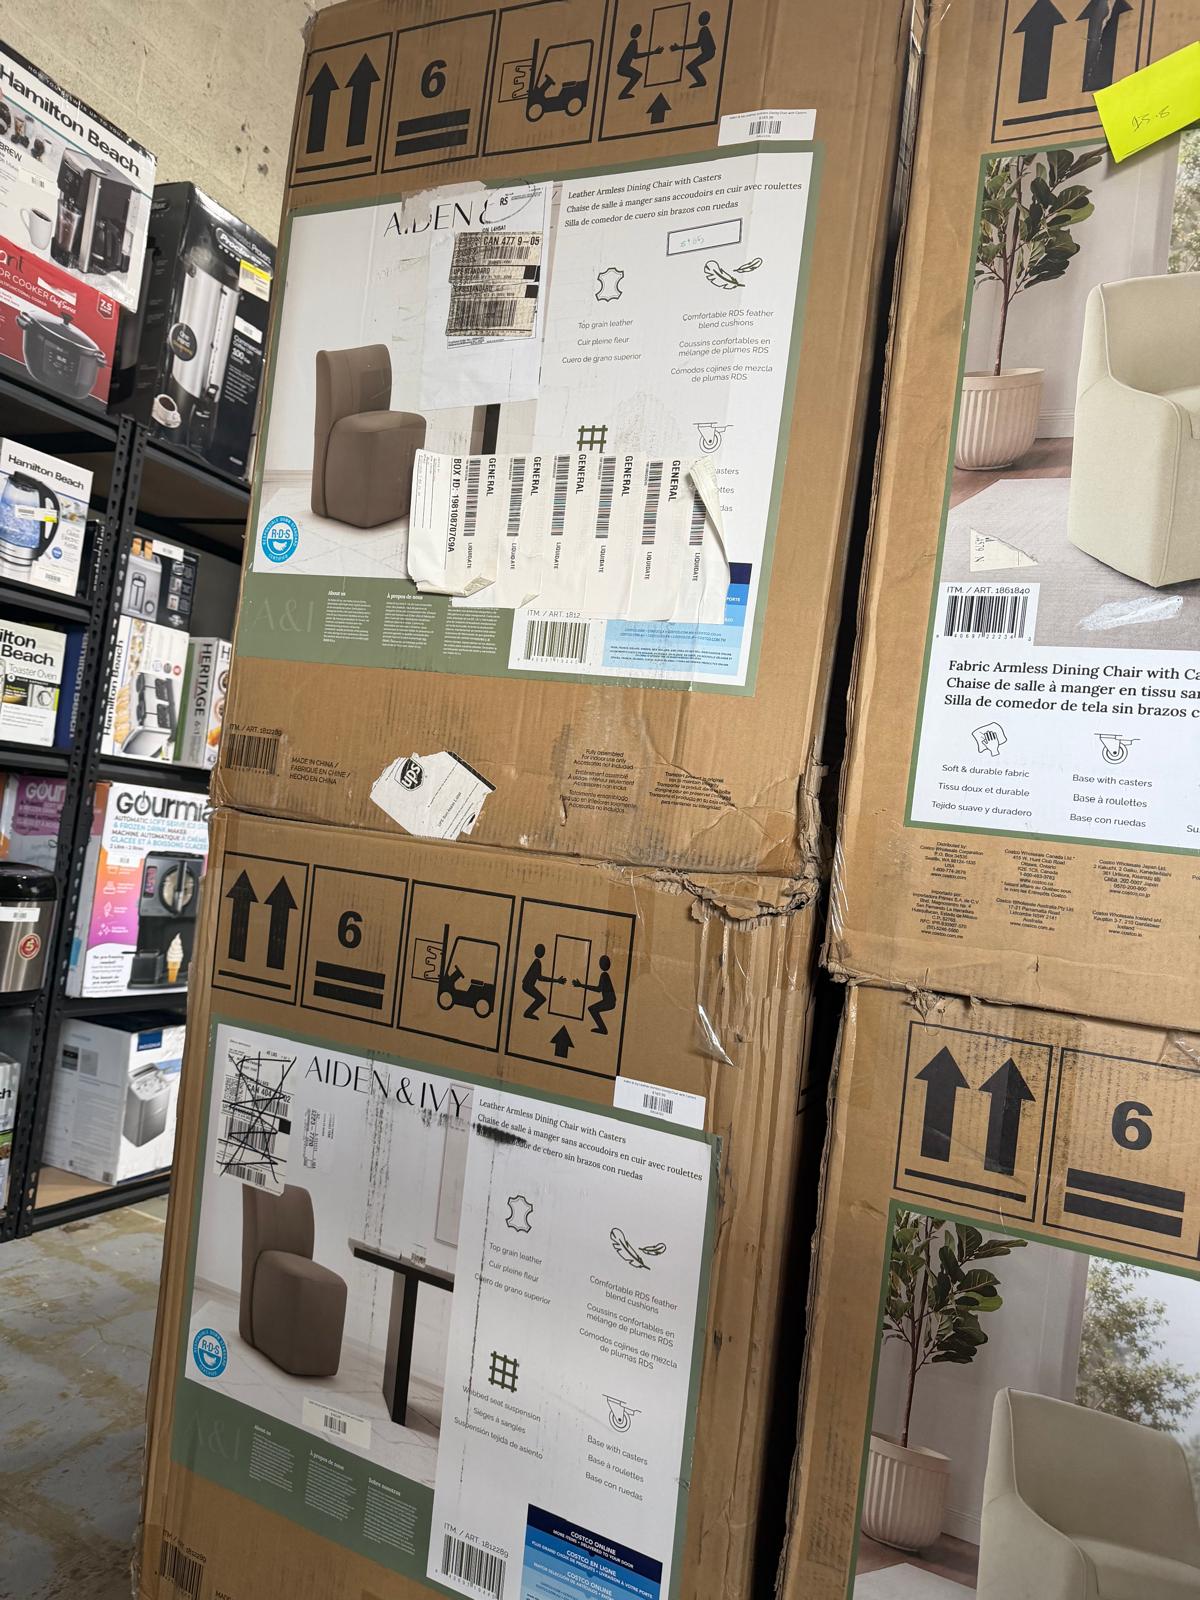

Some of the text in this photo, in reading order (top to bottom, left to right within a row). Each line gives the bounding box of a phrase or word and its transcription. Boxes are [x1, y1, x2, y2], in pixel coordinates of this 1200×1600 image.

[421, 59, 447, 98] 6
[0, 64, 141, 178] Hamilton Beach
[567, 204, 589, 213] Chaise
[591, 202, 600, 210] de
[601, 200, 617, 209] salle
[619, 199, 623, 207] à
[625, 196, 652, 207] manger
[654, 194, 670, 202] sans
[672, 189, 713, 201] accoudoirs
[727, 185, 741, 193] cuir
[744, 183, 762, 191] avec
[764, 181, 802, 190] roulettes
[568, 173, 722, 199] Leather Armless Dining Chair with Casters
[565, 200, 738, 227] Silla de comedor de cuero sin brazos con ruedas
[12, 275, 49, 300] COOKER
[578, 319, 633, 330] Top grain leather
[683, 310, 727, 322] Comfortable
[746, 309, 773, 317] feather
[698, 319, 753, 329] blend cushions
[8, 454, 84, 490] Hamilton Beach
[453, 458, 462, 476] BOX
[486, 458, 496, 496] GENERAL
[531, 456, 541, 496] GENERAL
[576, 454, 586, 494] GENERAL
[622, 455, 633, 496] GENERAL
[668, 460, 681, 502] GENERAL
[946, 586, 964, 594] ITM.
[995, 587, 1030, 595] 1861840
[1, 644, 54, 667] Beach
[9, 663, 57, 681] Toaster Oven
[194, 643, 213, 718] HERITAGE
[949, 661, 1179, 680] Fabric Armless Dining Chair with
[103, 640, 124, 736] Hamilton Beach
[946, 678, 1176, 701] Chaise de salle à manger en tissu
[944, 695, 1186, 717] Silla de comedor de tela sin brazos
[401, 761, 421, 789] ups
[942, 764, 959, 773] Soft
[970, 766, 1003, 776] durable
[1005, 768, 1029, 778] fabric
[1072, 774, 1152, 788] Base with casters
[939, 782, 960, 791] Tissu
[962, 784, 983, 793] doux
[995, 786, 1029, 797] durable
[337, 910, 363, 949] 6
[305, 1055, 470, 1117] AIDEN & IVY
[479, 1099, 626, 1144] Leather Armless Dining Chair with Casters
[1111, 1100, 1153, 1151] 6
[478, 1114, 703, 1181] Chaise de salle à manger sans accoudoirs en cuir avec roulettes
[586, 1312, 674, 1347] mélange de plumes RDS
[587, 1302, 675, 1338] Coussins confortables en
[587, 1435, 648, 1465] Base with casters
[465, 1532, 481, 1544] ART.
[570, 1531, 617, 1556] COSTCO ONLINE
[566, 1550, 590, 1565] COSTCO
